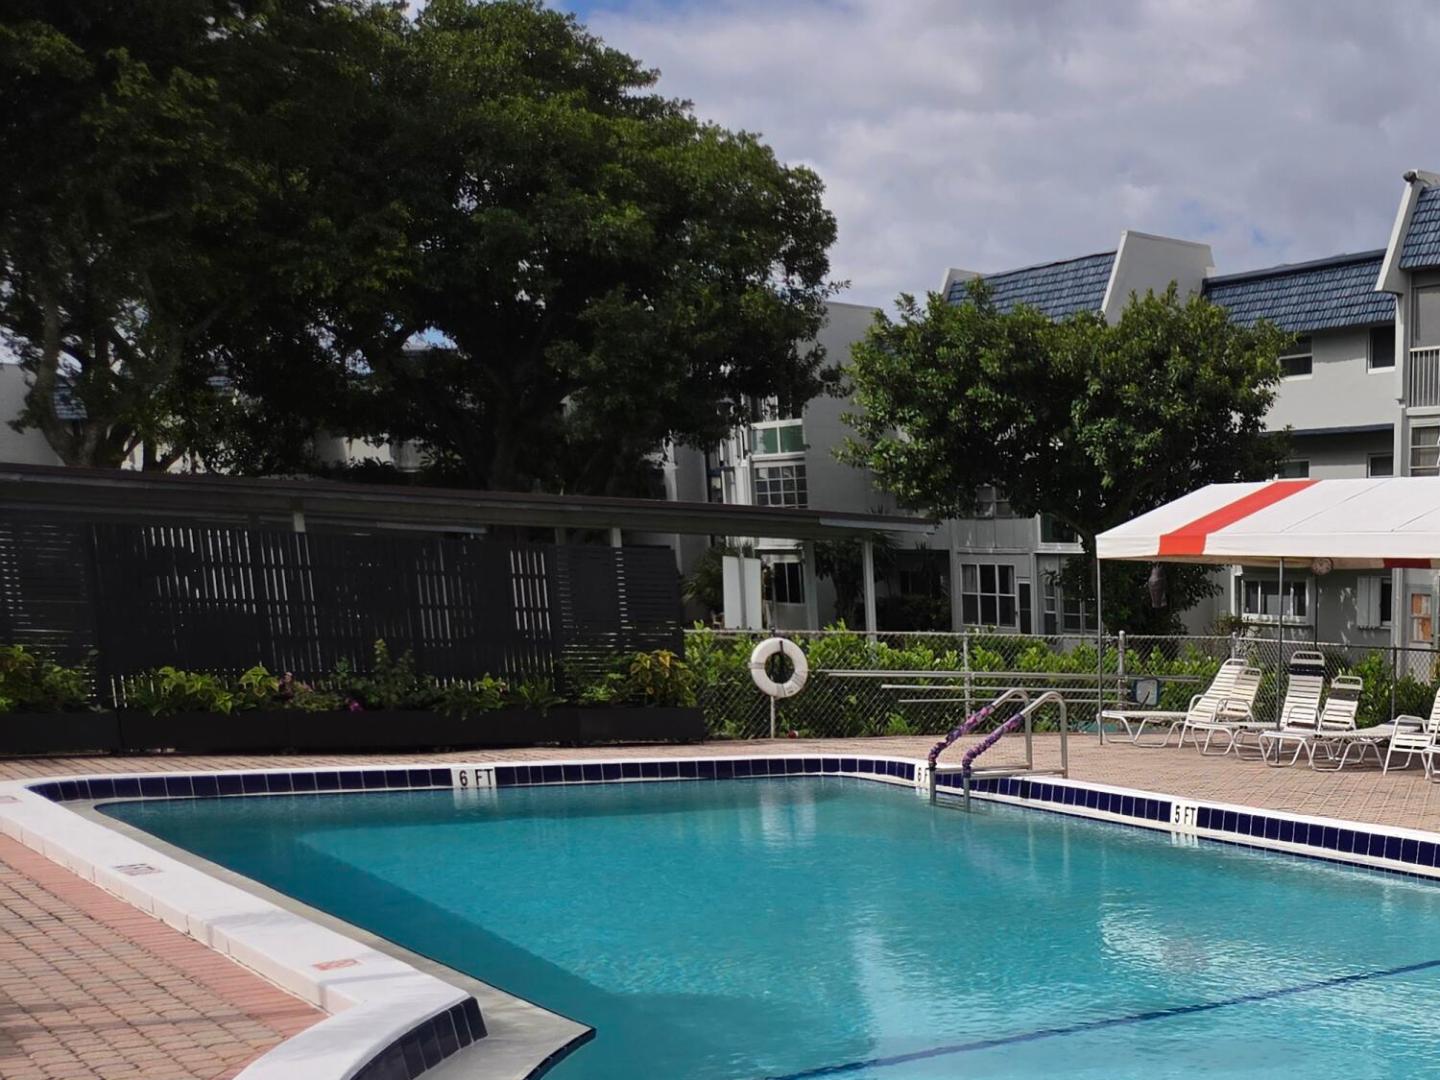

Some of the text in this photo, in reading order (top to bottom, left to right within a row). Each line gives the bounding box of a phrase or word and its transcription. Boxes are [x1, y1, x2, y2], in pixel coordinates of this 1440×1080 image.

[459, 768, 494, 787] 6 FT
[1174, 805, 1196, 825] 5 FT
